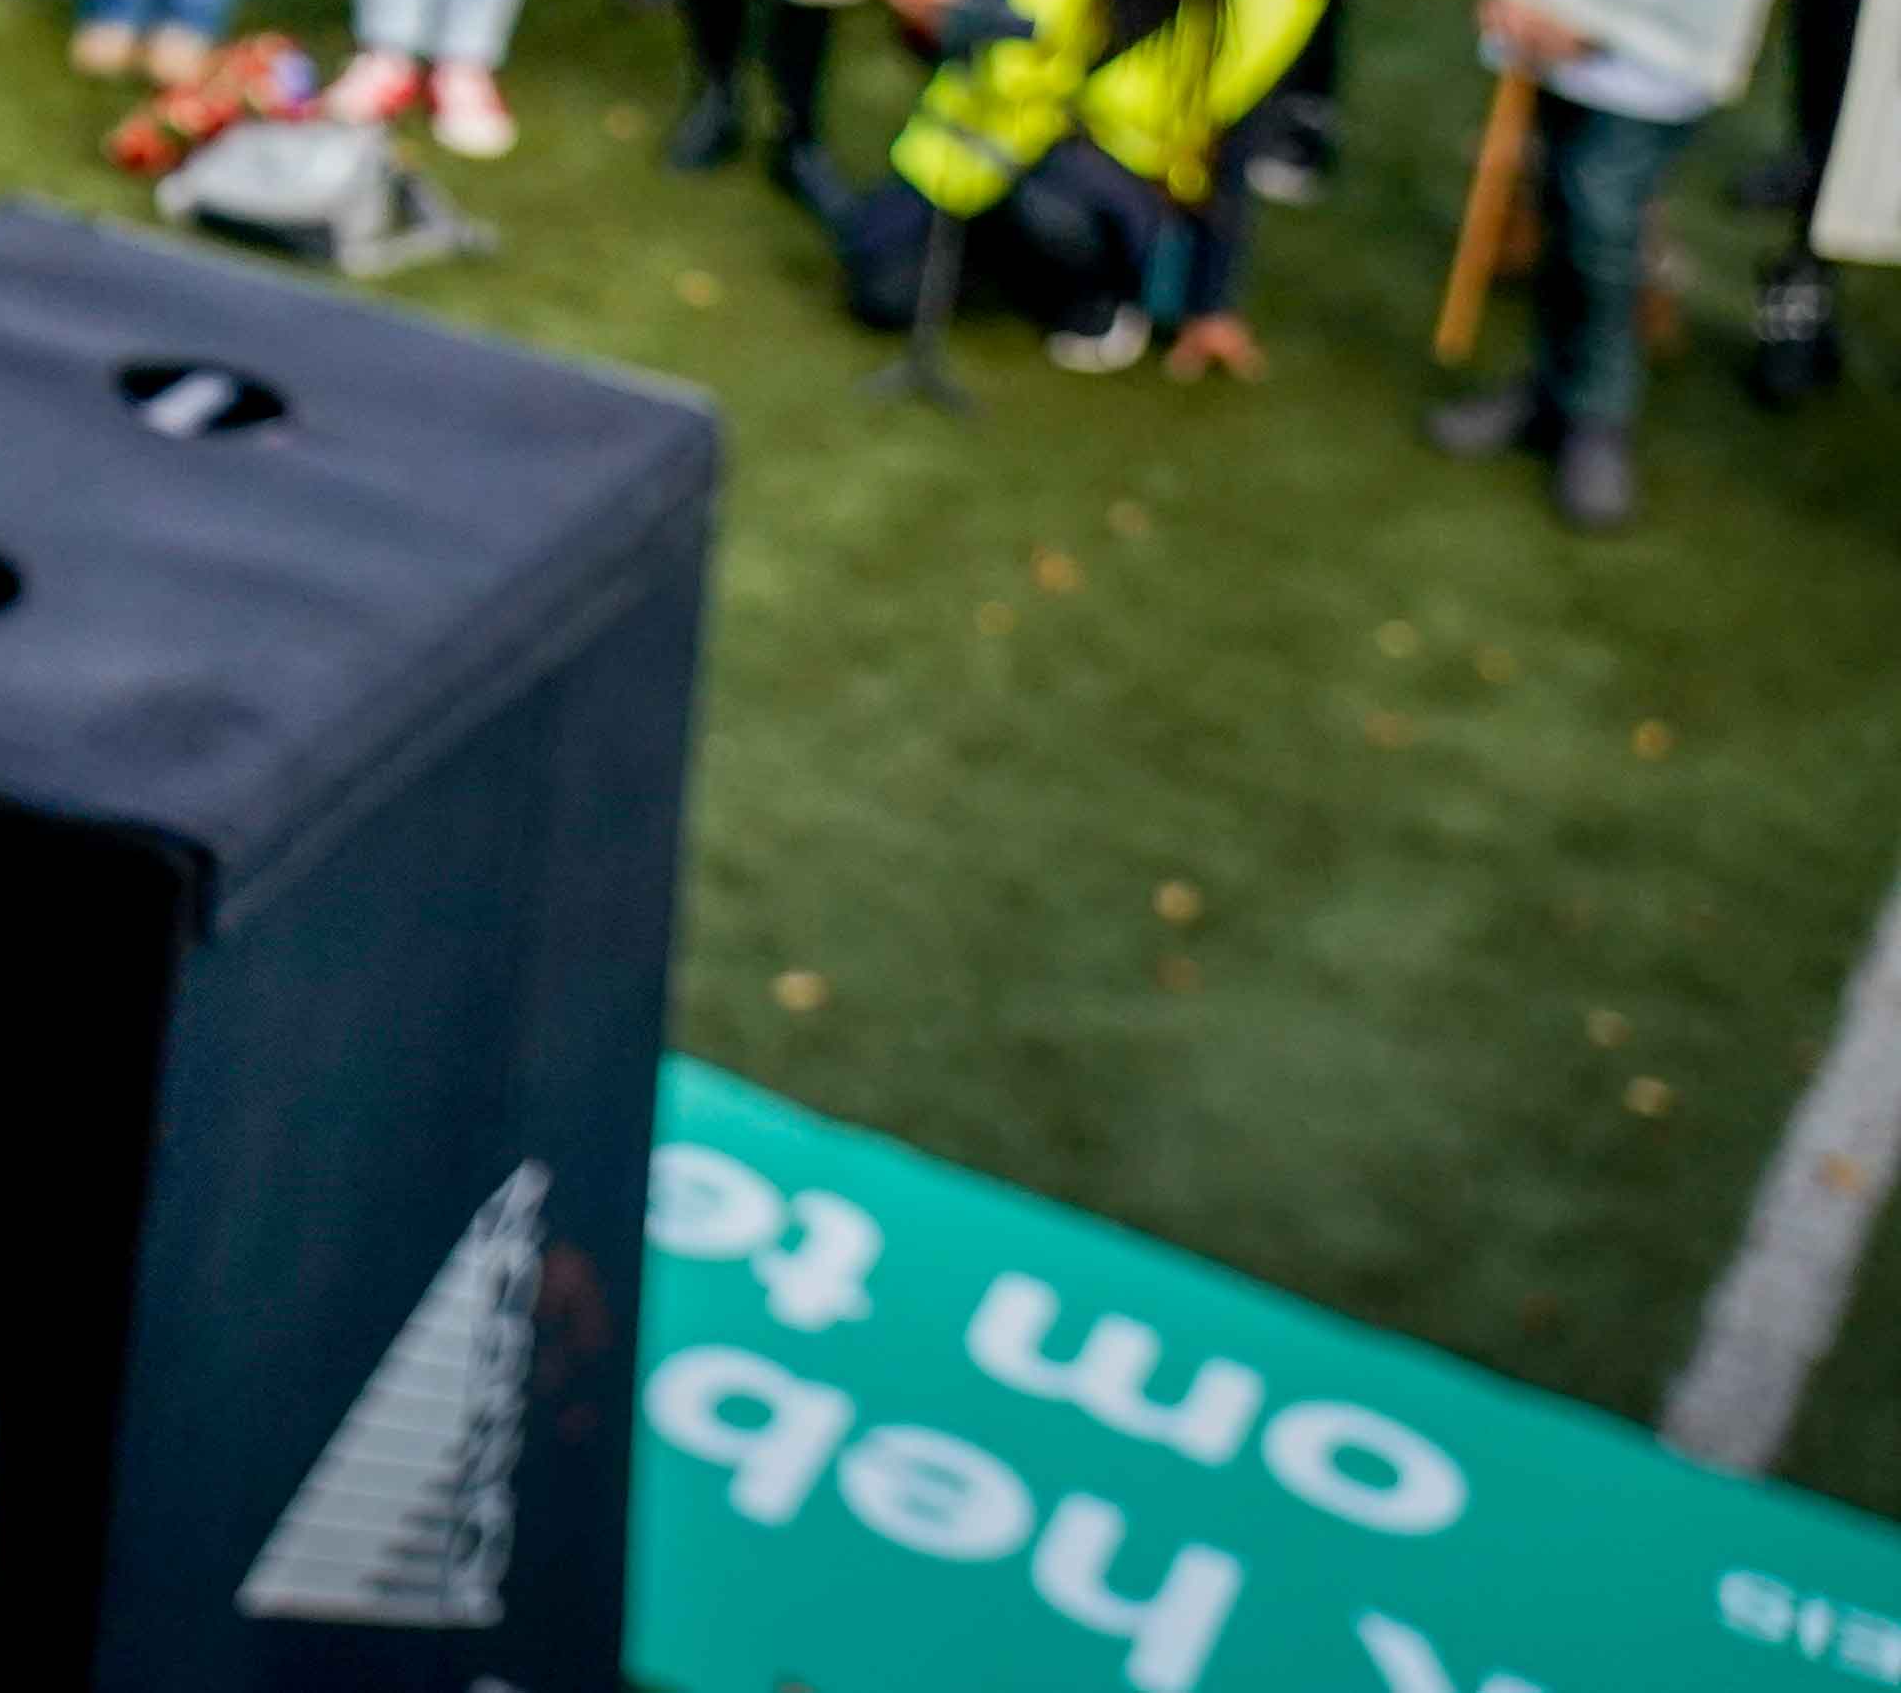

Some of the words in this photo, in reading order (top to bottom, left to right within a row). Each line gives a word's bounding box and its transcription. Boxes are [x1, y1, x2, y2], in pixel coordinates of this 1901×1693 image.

[644, 1141, 885, 1333] te
[642, 1343, 1244, 1693] heb
[964, 1270, 1468, 1536] om
